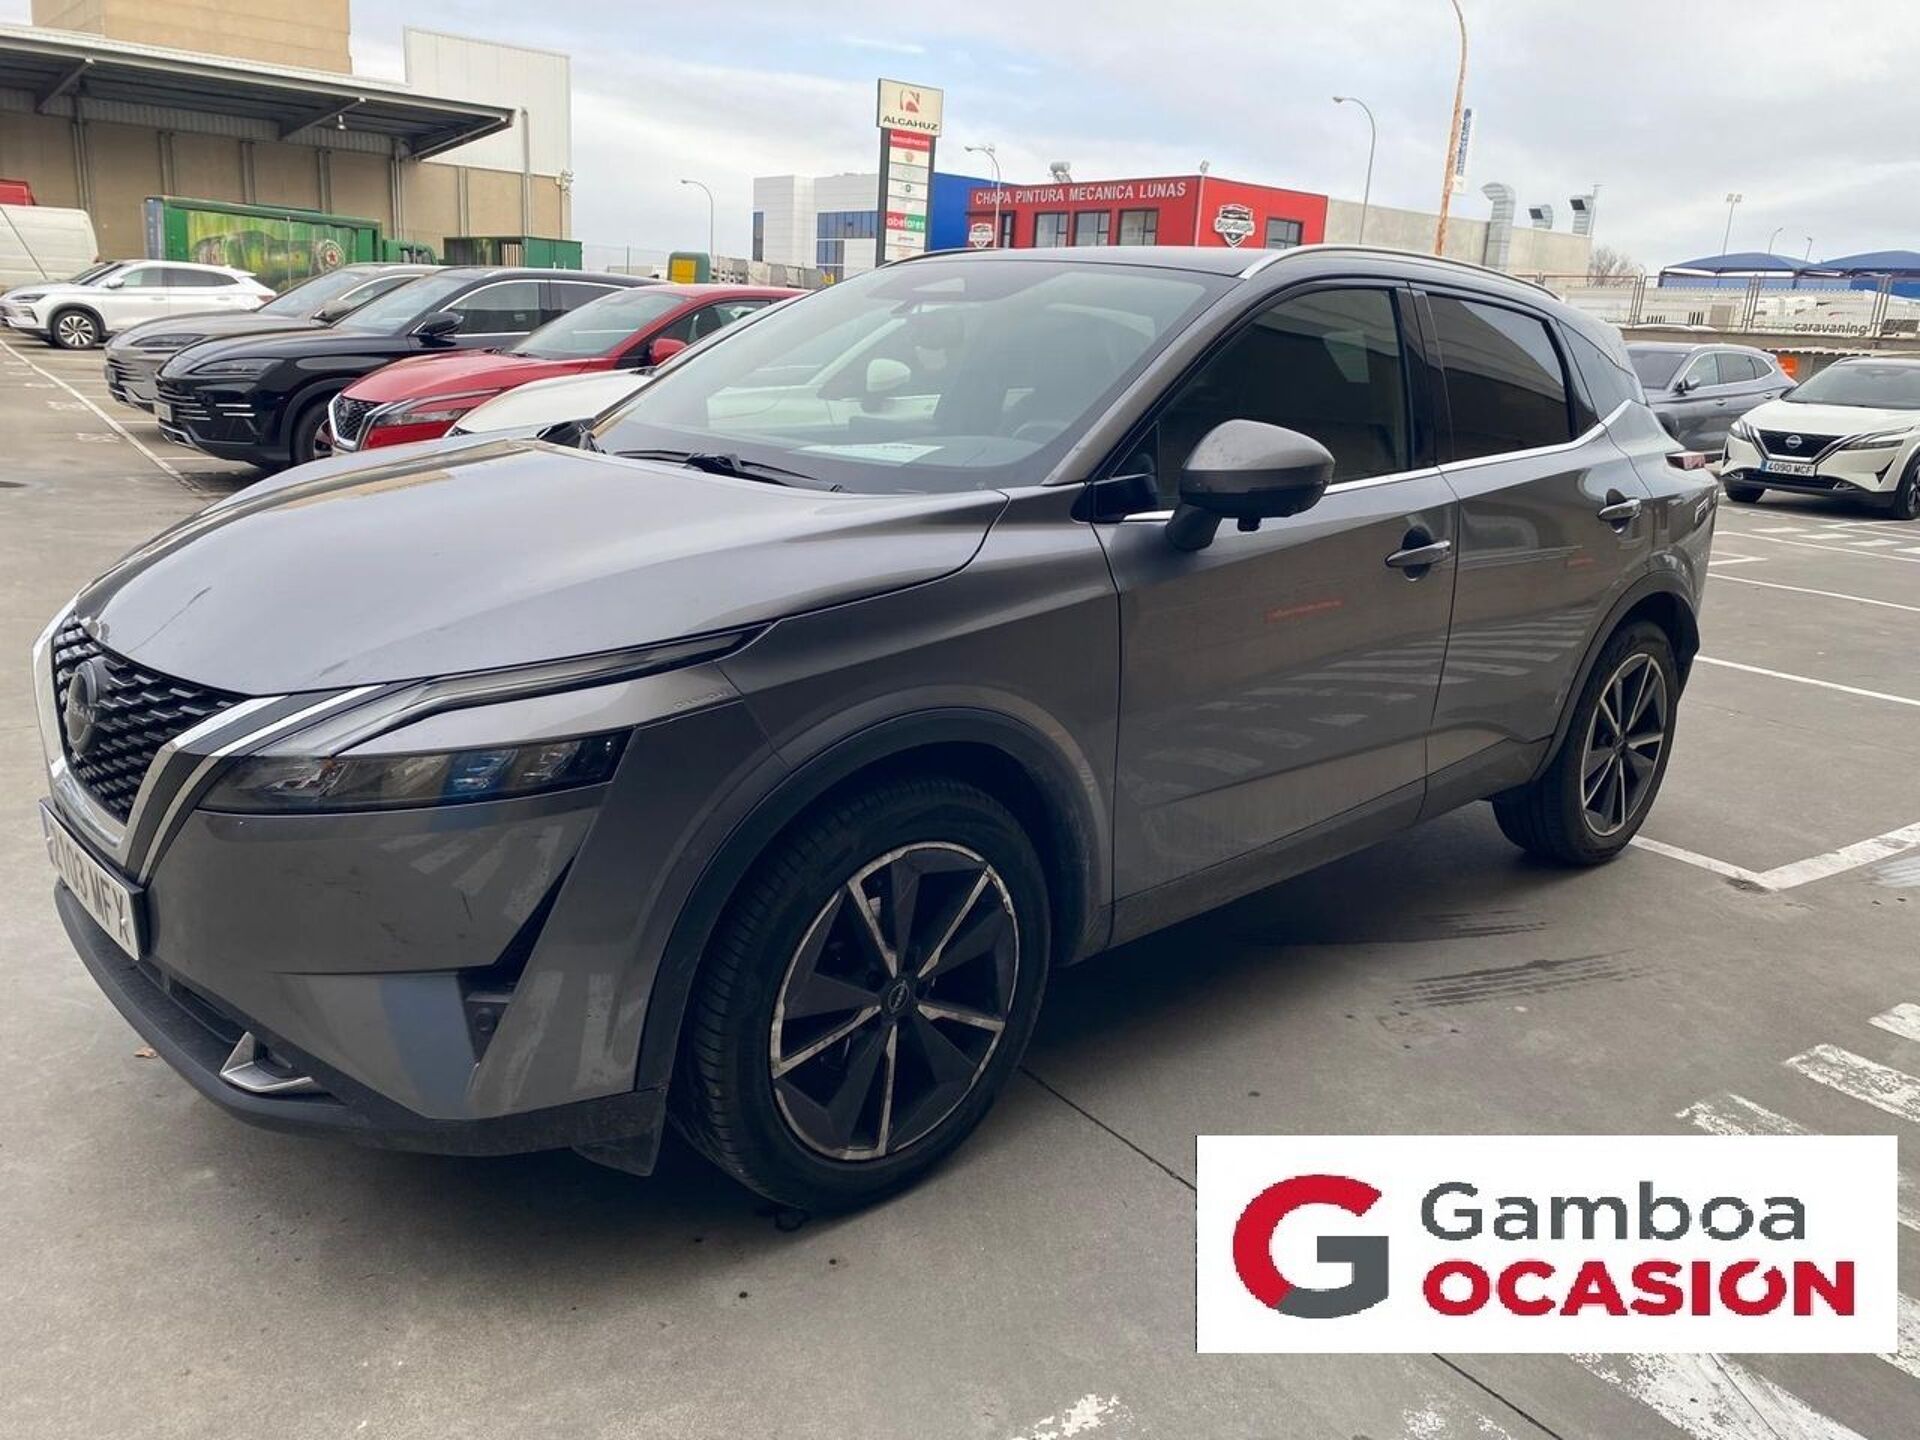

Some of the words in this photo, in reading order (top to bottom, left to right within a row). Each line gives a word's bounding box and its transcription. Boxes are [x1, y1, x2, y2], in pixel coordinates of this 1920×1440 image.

[883, 115, 938, 130] ALCAHUZ
[976, 189, 1012, 205] CHAPA
[1015, 187, 1064, 204] PINTURA
[1069, 184, 1134, 201] MECANICA
[1140, 181, 1186, 198] LUNAS
[1793, 321, 1868, 336] caravaning
[1769, 462, 1792, 472] 4090
[88, 864, 131, 946] MFX
